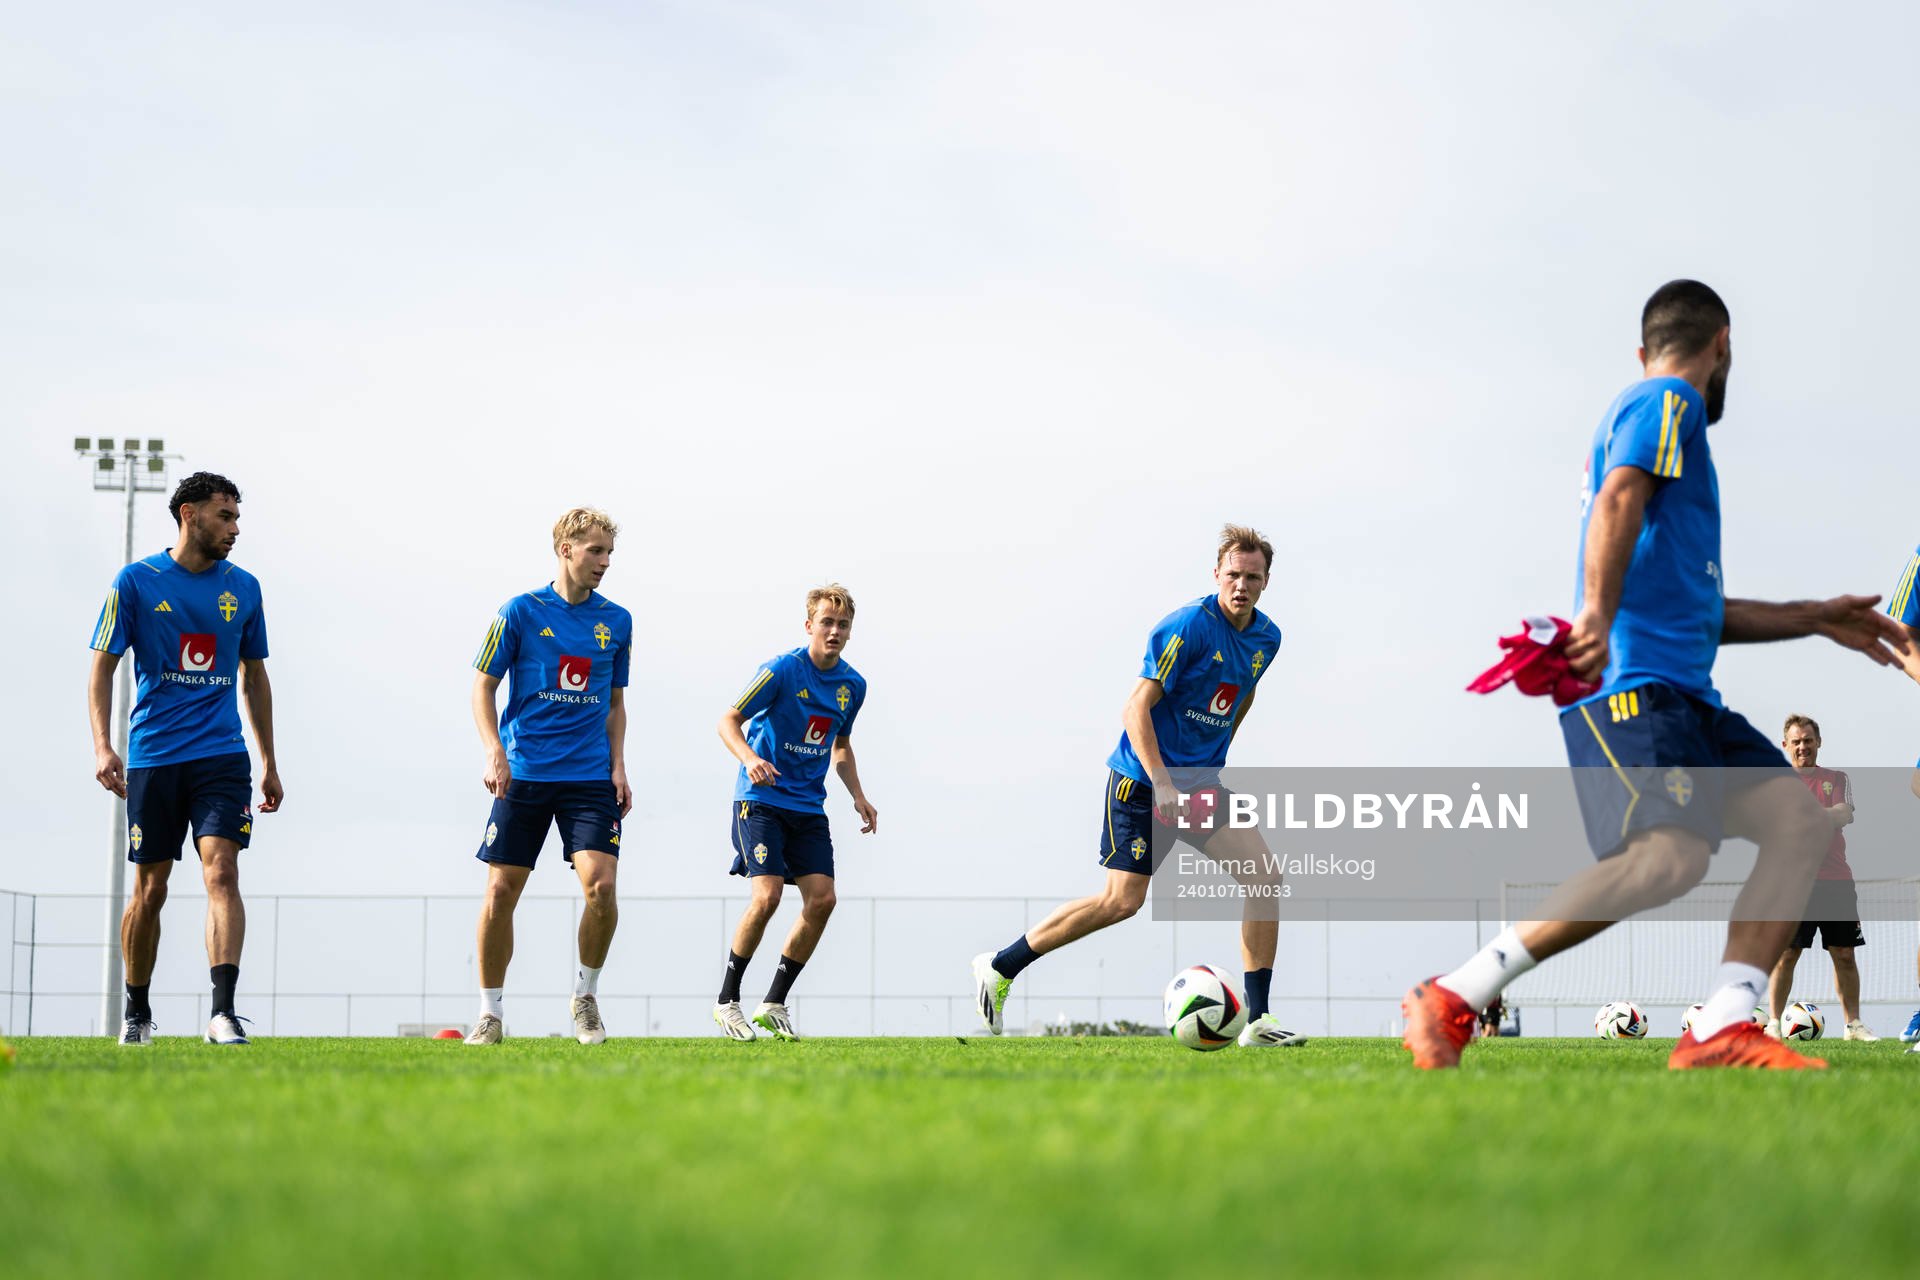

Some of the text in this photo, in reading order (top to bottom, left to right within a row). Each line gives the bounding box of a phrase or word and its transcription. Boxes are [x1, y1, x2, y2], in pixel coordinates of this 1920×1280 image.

[161, 672, 232, 685] SVENSKA SPEL
[538, 691, 580, 704] SVENSKA
[1185, 709, 1220, 727] SVENSKA
[783, 742, 818, 756] SVENSKA
